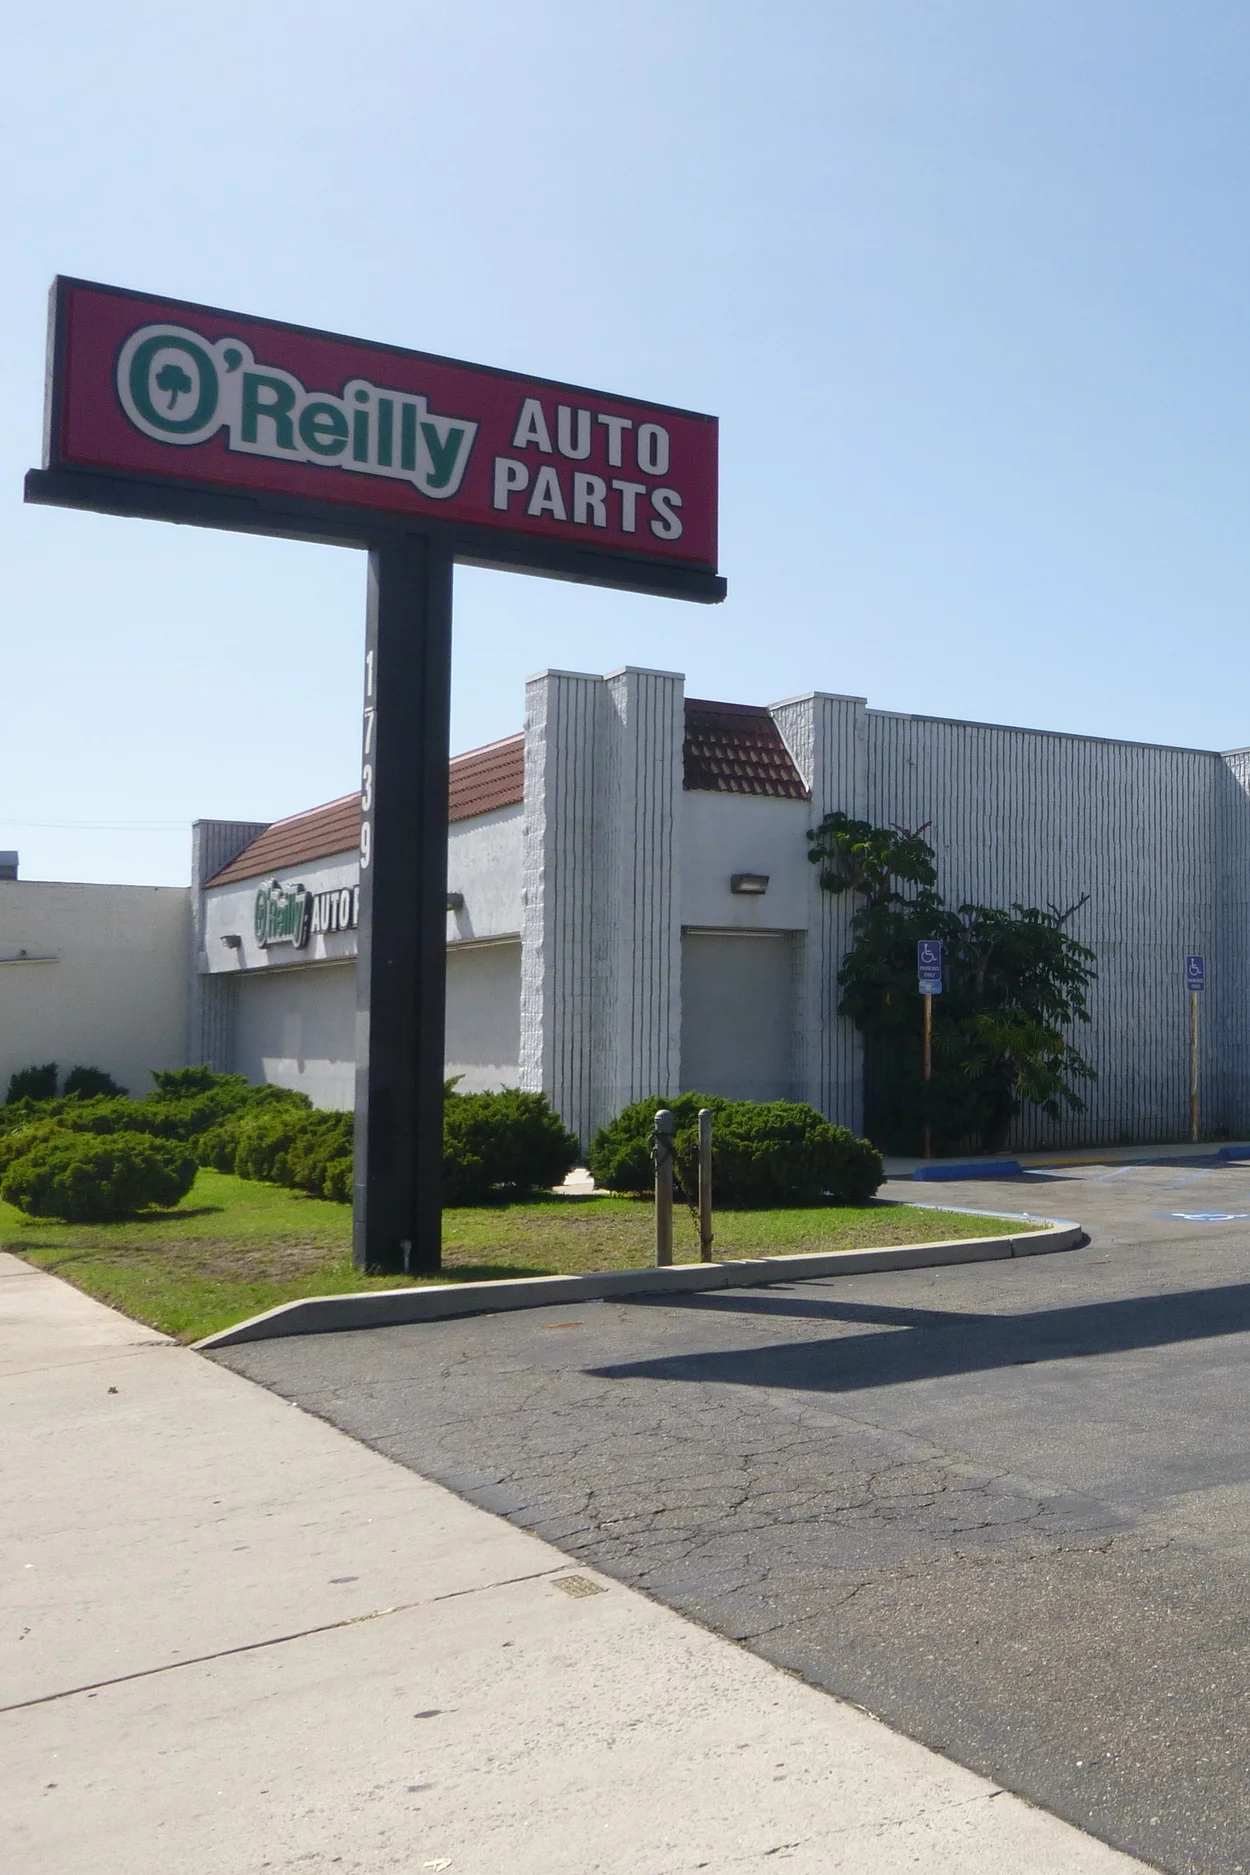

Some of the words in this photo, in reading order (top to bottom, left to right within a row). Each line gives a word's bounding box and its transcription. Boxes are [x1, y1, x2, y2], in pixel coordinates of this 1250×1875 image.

[121, 330, 470, 493] O'Reilly
[512, 398, 671, 476] AUTO
[493, 457, 684, 540] PARTS
[310, 888, 350, 932] AUTO
